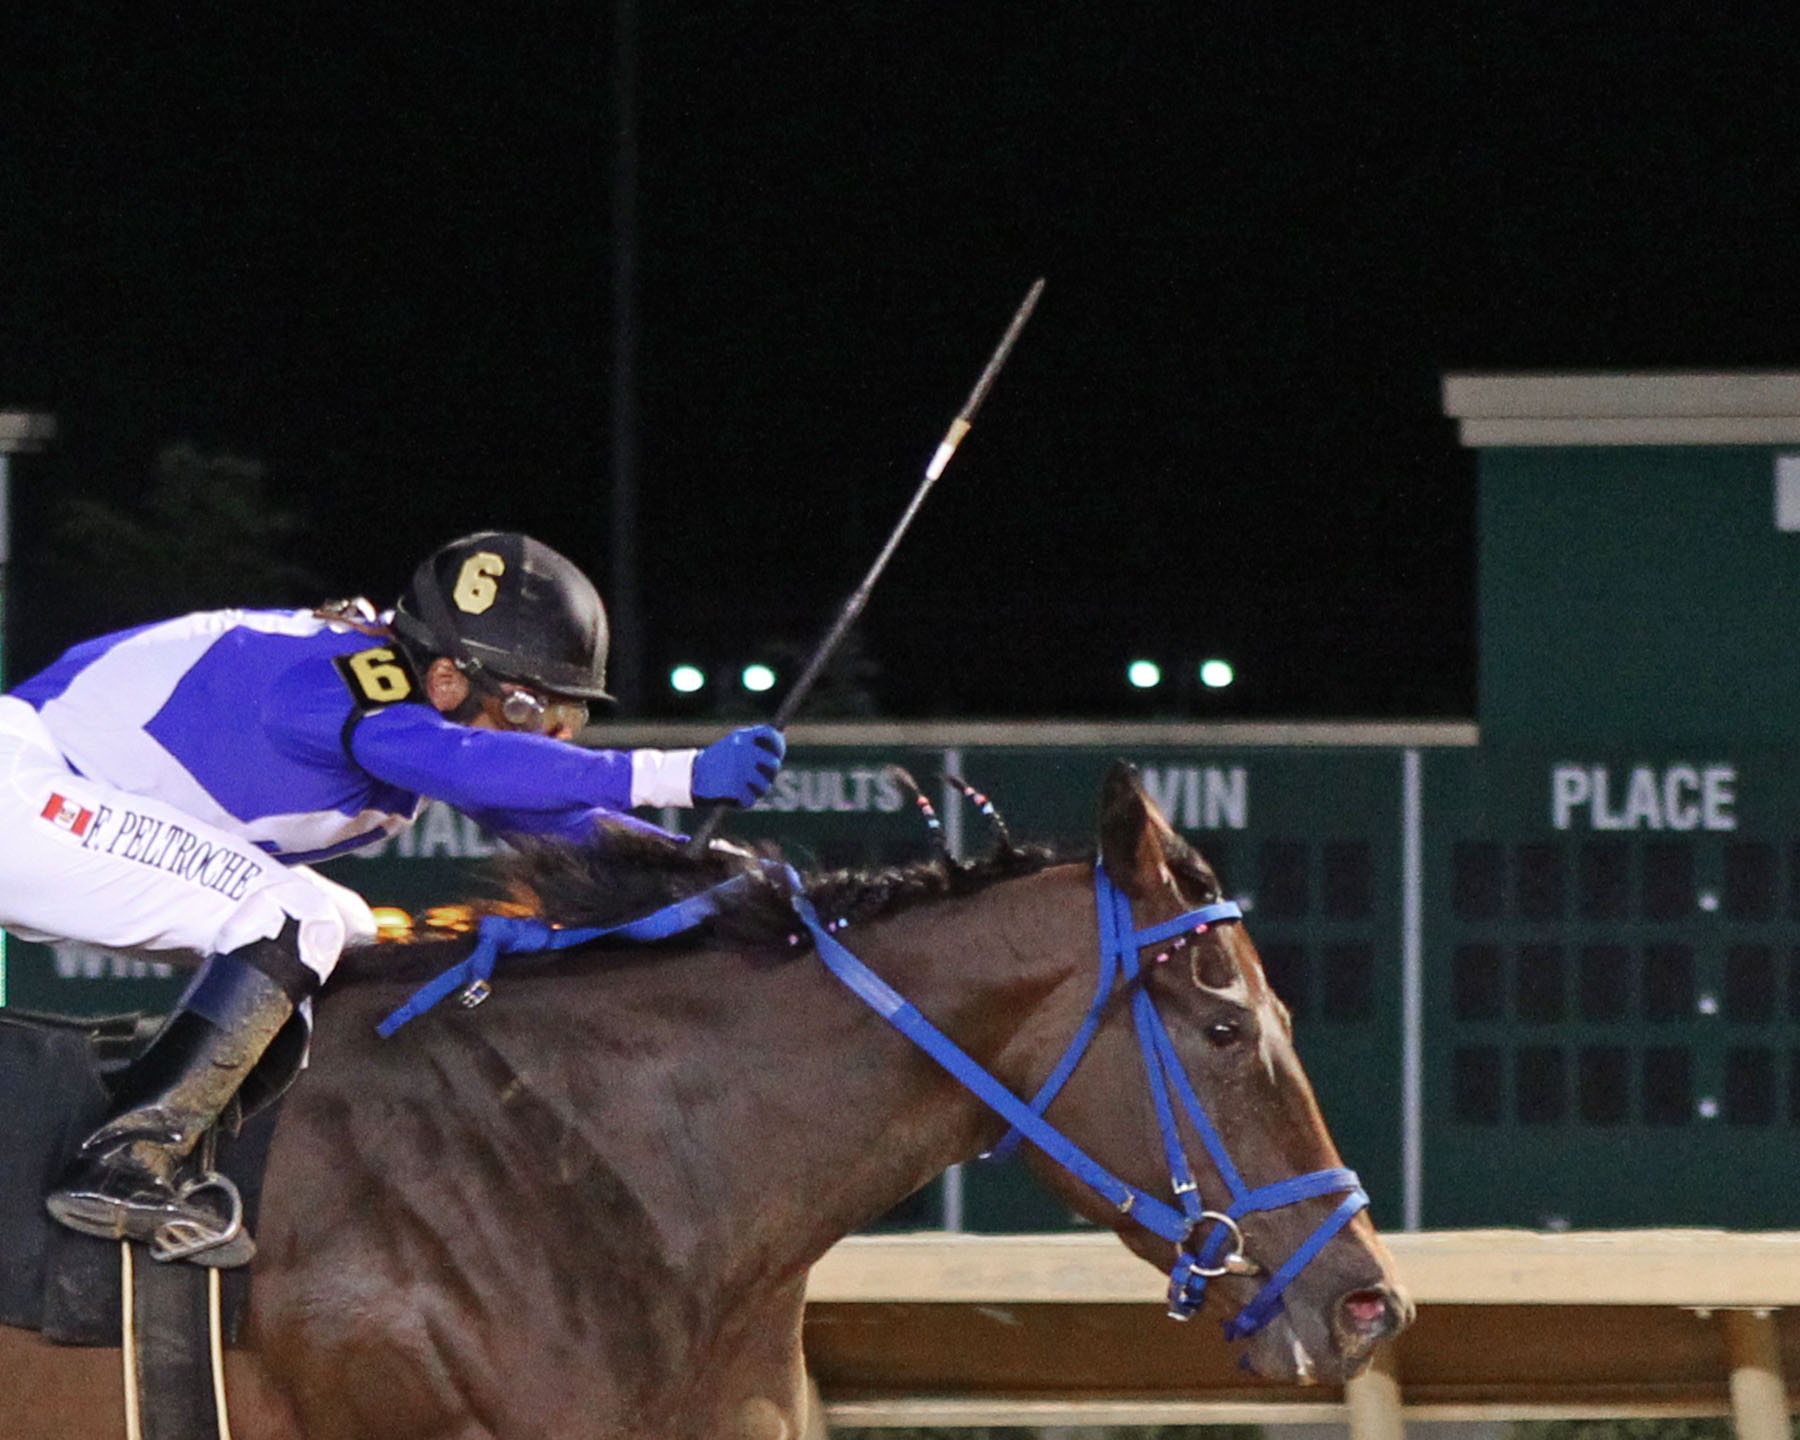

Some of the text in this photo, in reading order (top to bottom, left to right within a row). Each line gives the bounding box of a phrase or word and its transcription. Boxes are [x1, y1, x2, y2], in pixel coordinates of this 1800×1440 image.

[453, 551, 505, 615] 6
[349, 647, 412, 703] 6
[745, 768, 903, 812] SULTS
[1552, 764, 1739, 832] PLACE
[81, 804, 263, 901] F. PELTROCHE
